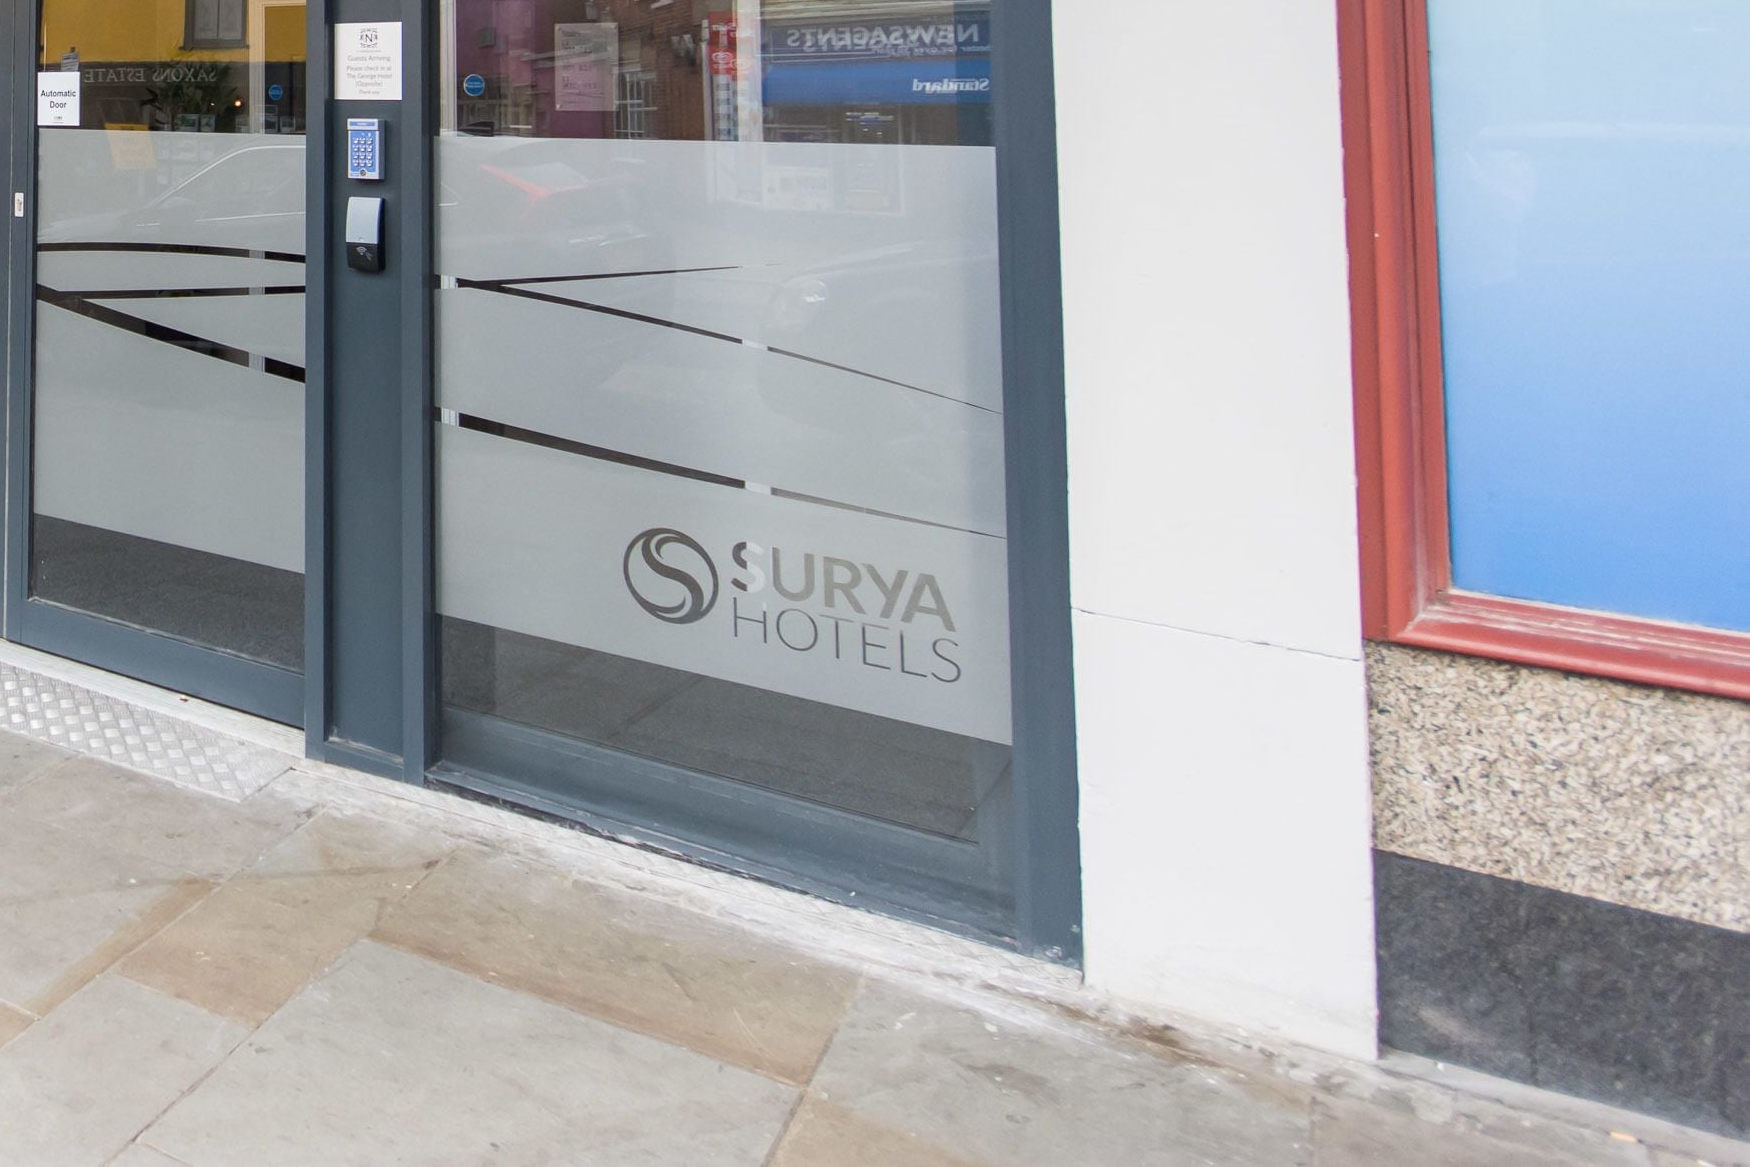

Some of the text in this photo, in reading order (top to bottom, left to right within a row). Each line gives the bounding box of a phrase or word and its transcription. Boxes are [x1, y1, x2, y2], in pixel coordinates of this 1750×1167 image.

[40, 89, 76, 98] Automatic
[49, 100, 67, 109] Door
[729, 540, 957, 633] SURYA
[731, 596, 962, 684] HOTELS
